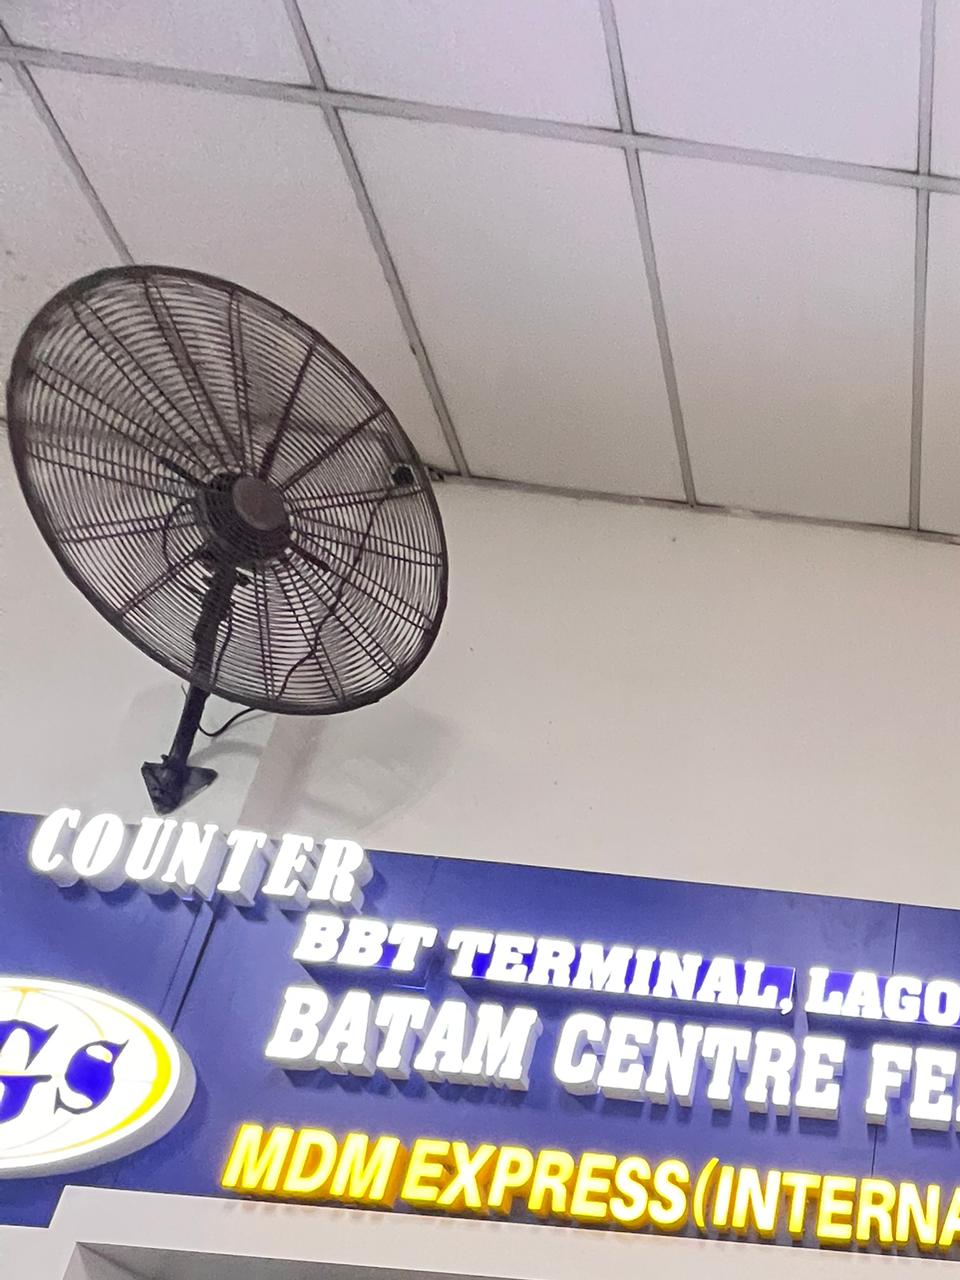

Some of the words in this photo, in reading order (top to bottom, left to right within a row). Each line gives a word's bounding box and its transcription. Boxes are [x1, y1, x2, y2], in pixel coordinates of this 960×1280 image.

[30, 807, 366, 903] COUNTER
[293, 912, 438, 971] BBT
[447, 928, 793, 1015] TERMINAL,
[265, 985, 538, 1080] BATAM
[553, 1013, 846, 1110] CENTRE
[221, 1123, 400, 1201] MDM
